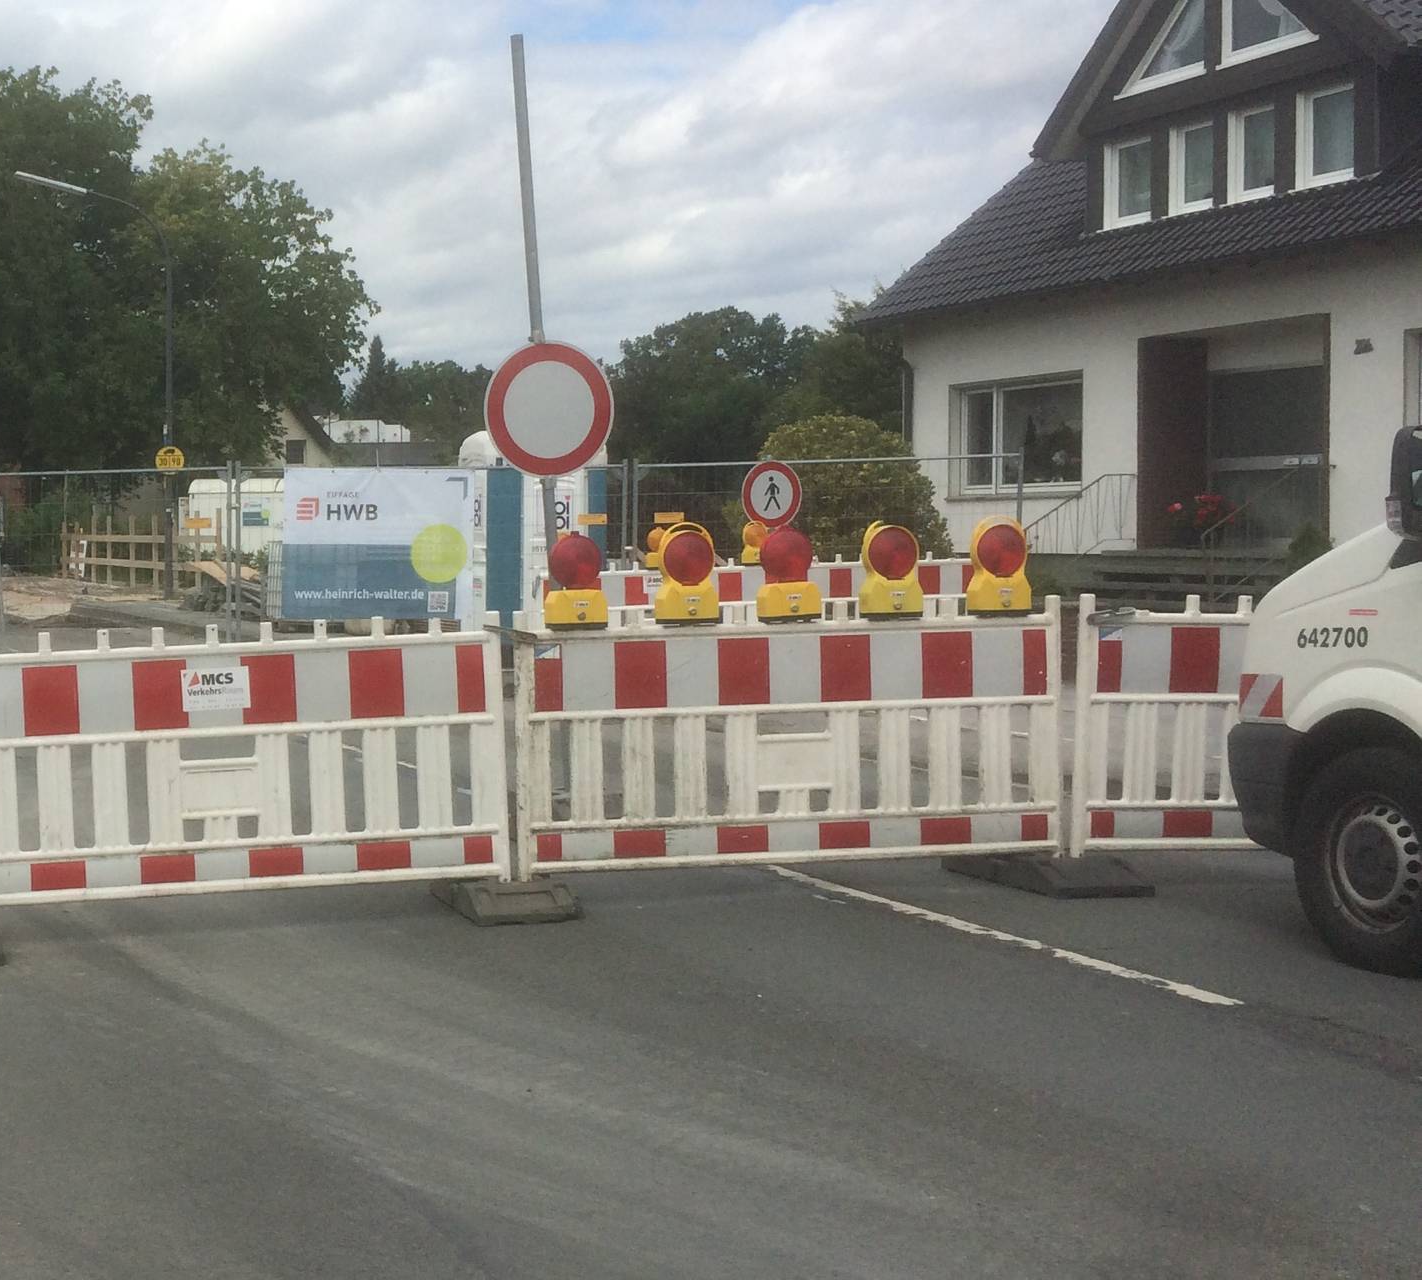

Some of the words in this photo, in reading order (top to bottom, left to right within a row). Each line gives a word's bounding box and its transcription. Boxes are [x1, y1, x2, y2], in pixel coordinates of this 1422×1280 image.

[326, 503, 378, 521] HWB
[293, 588, 425, 600] www.heinrich-walter.de
[1297, 626, 1369, 649] 642700
[201, 672, 234, 686] MCS
